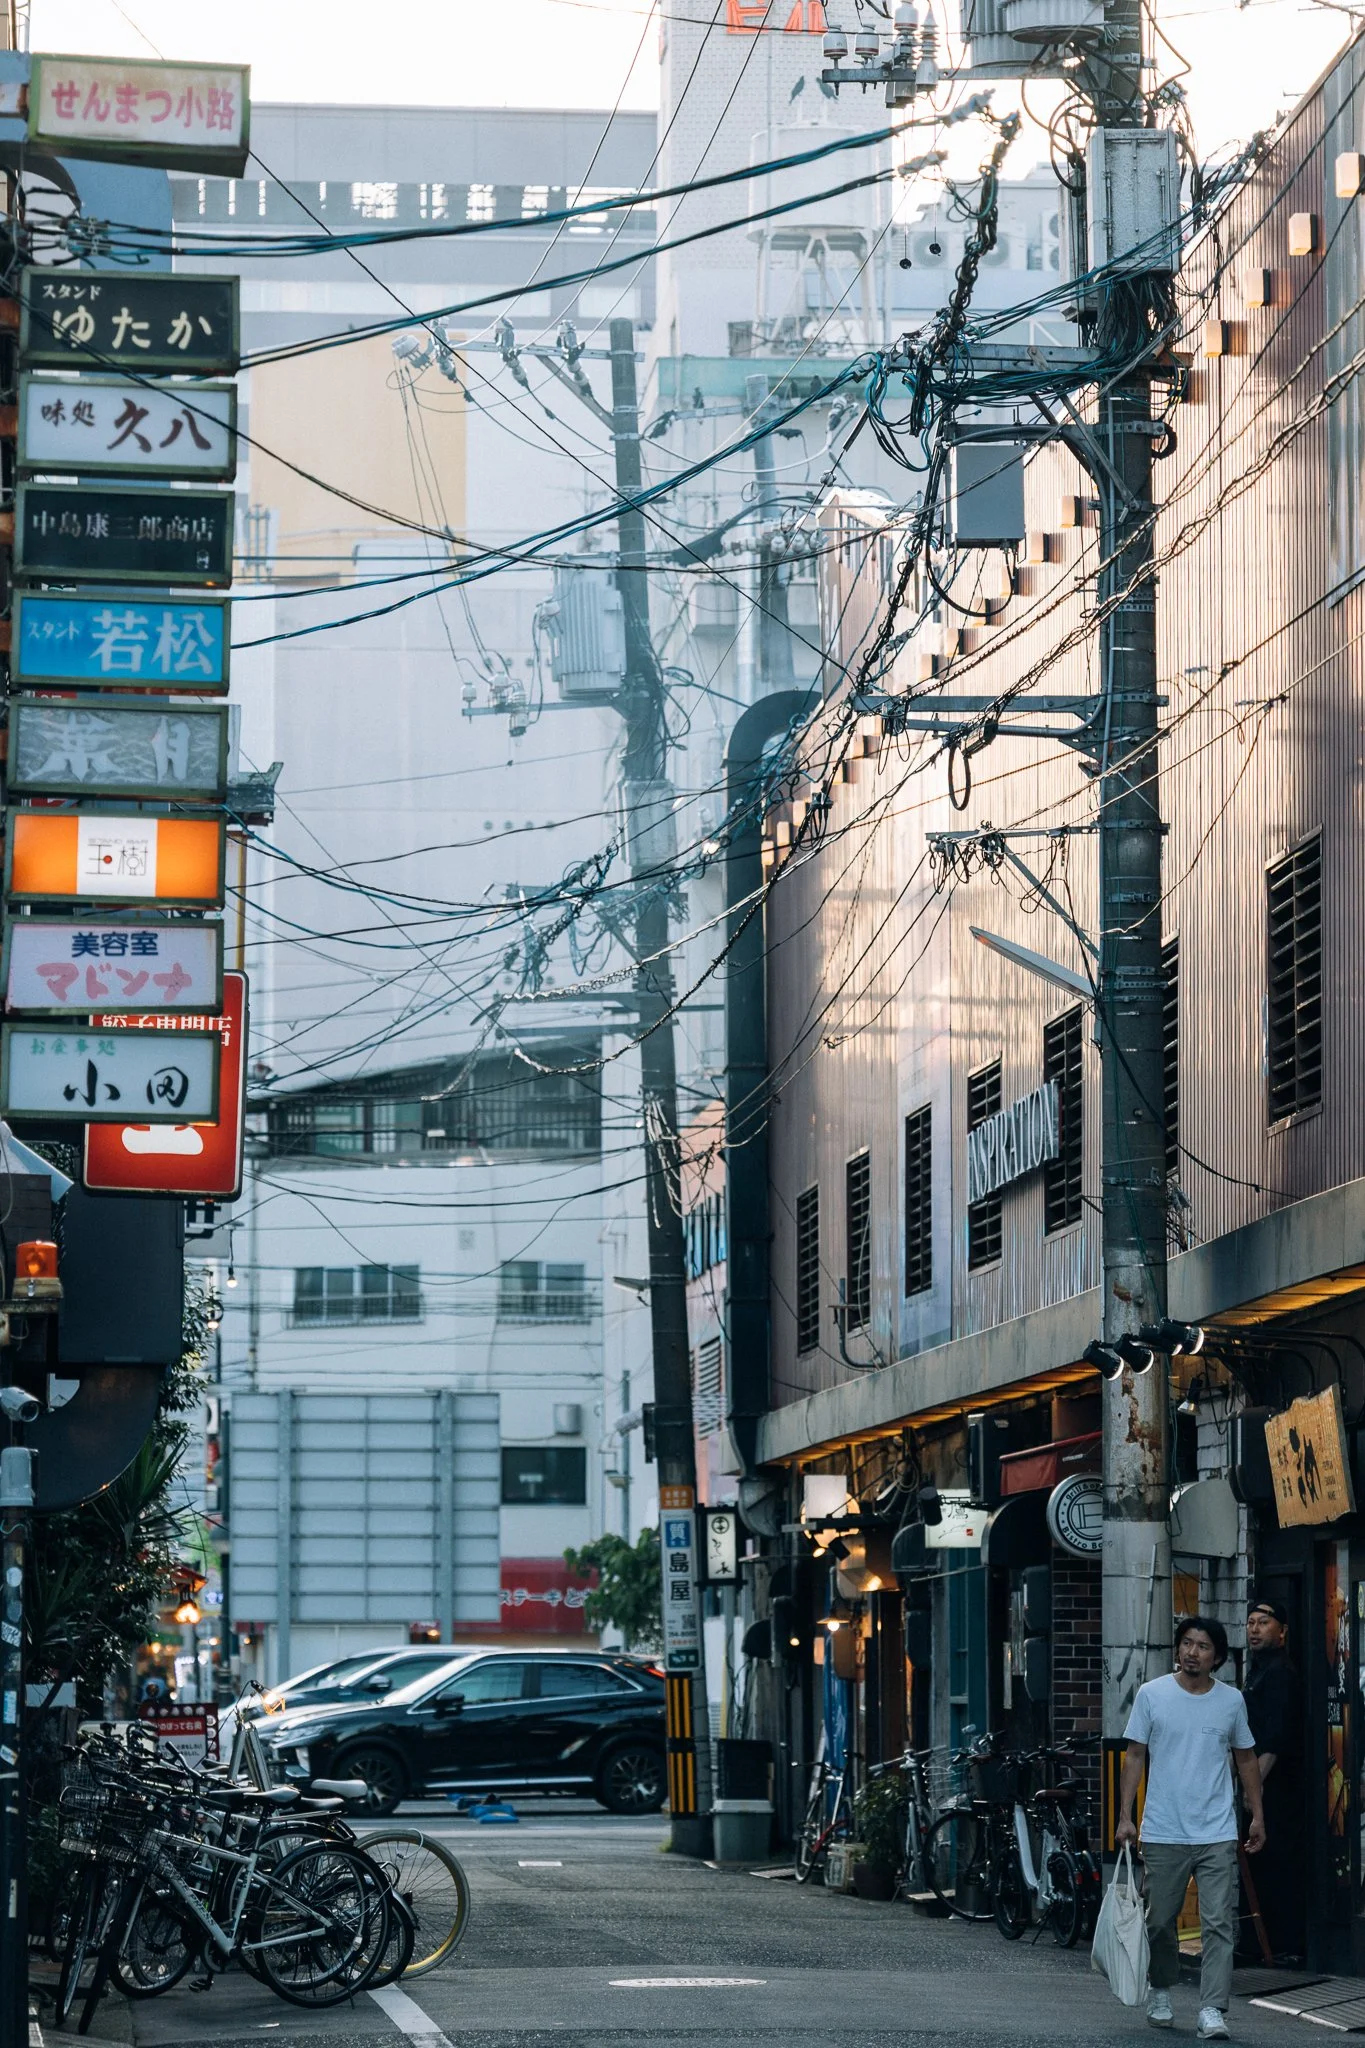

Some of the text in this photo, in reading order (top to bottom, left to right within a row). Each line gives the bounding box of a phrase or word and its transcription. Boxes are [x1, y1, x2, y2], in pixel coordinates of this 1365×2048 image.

[51, 79, 235, 131] せんまつ小路
[42, 283, 102, 300] スタンド
[53, 305, 212, 350] ゆたか
[41, 398, 212, 453] 味処 久八
[88, 608, 215, 675] 若松
[71, 931, 159, 958] 美容室
[36, 962, 193, 1001] マドンナ
[31, 1038, 116, 1056] お食事処
